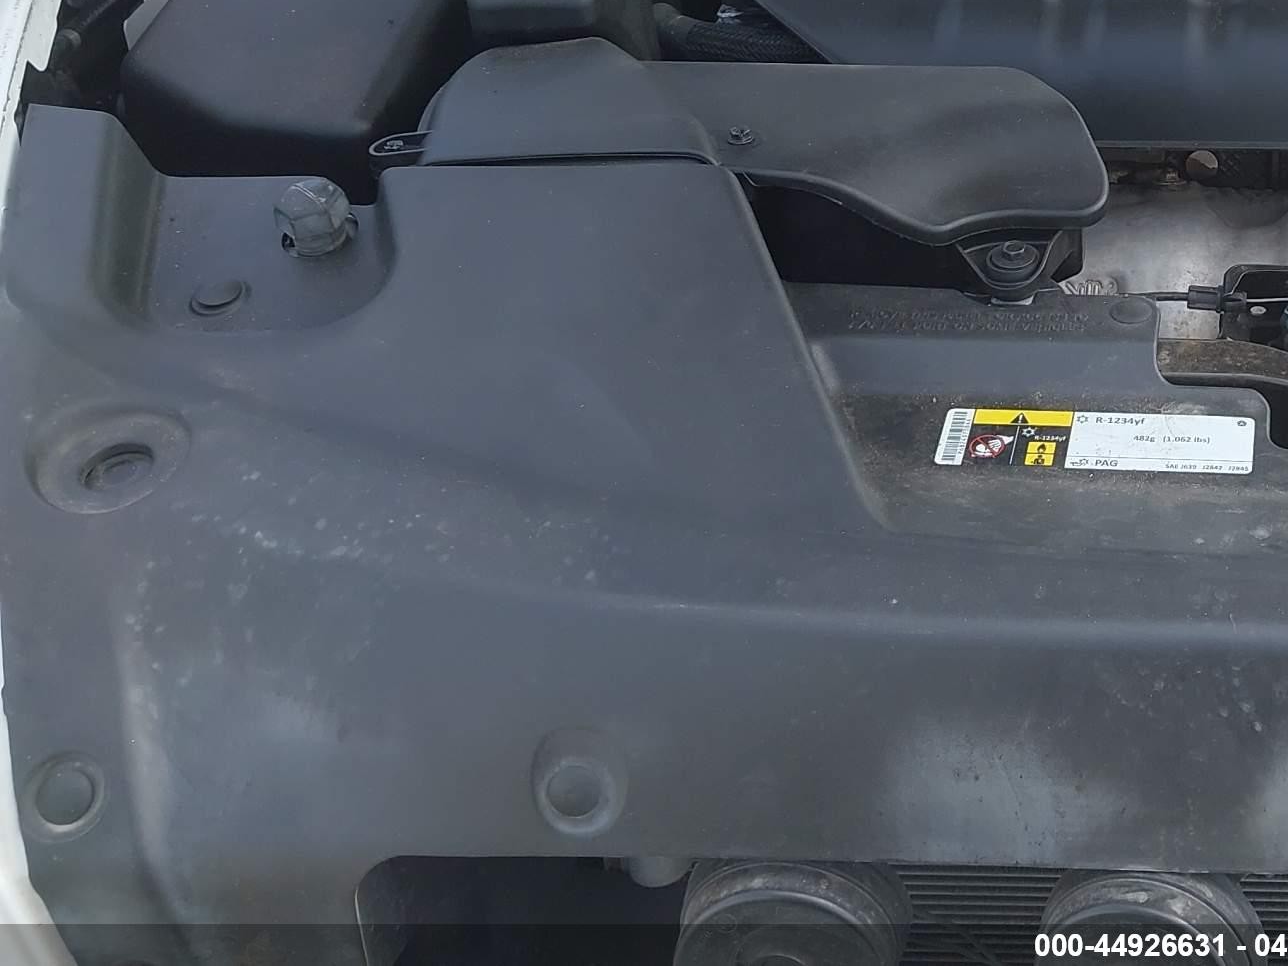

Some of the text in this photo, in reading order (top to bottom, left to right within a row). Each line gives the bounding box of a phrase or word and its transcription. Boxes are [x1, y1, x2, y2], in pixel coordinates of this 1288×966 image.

[1095, 416, 1146, 426] R-1234yf
[1133, 435, 1156, 443] 482g
[1094, 459, 1119, 468] PAG
